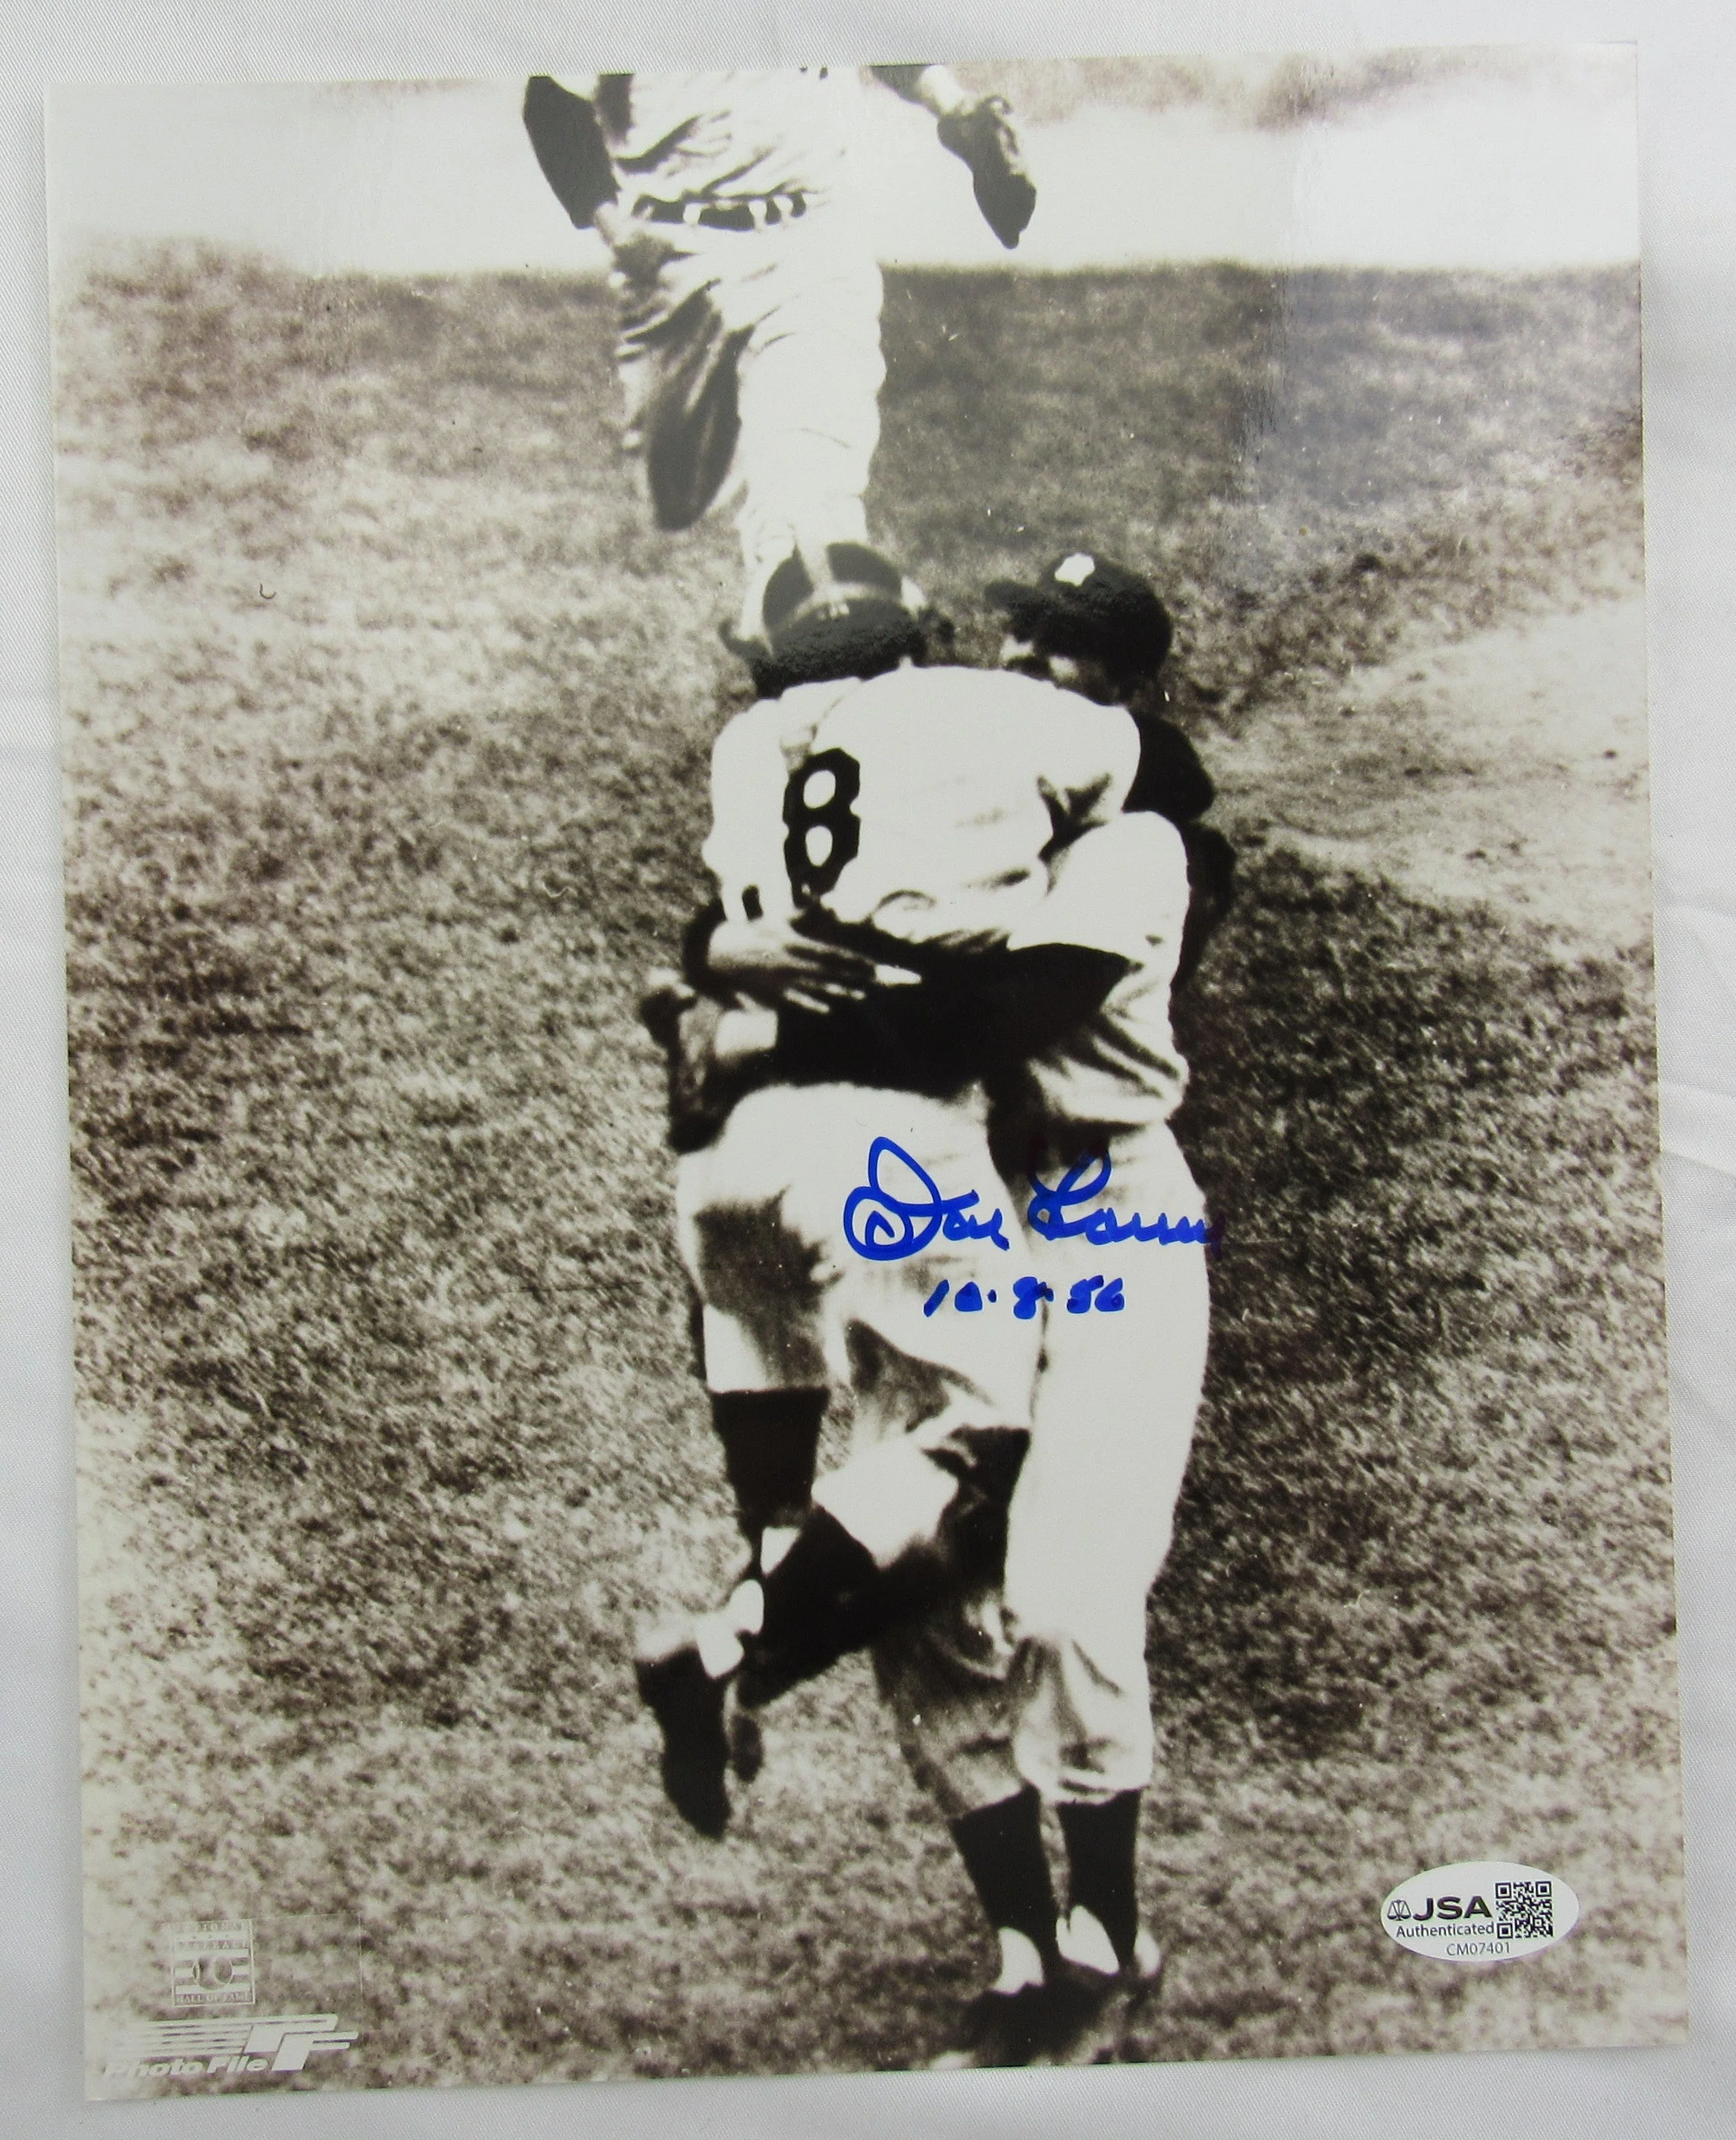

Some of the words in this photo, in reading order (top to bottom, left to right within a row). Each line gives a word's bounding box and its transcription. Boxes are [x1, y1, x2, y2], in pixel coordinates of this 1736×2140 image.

[783, 748, 861, 910] 8
[1413, 1895, 1493, 1921] JSA
[1396, 1921, 1495, 1938] Authenticated
[1446, 1942, 1511, 1957] CM07401
